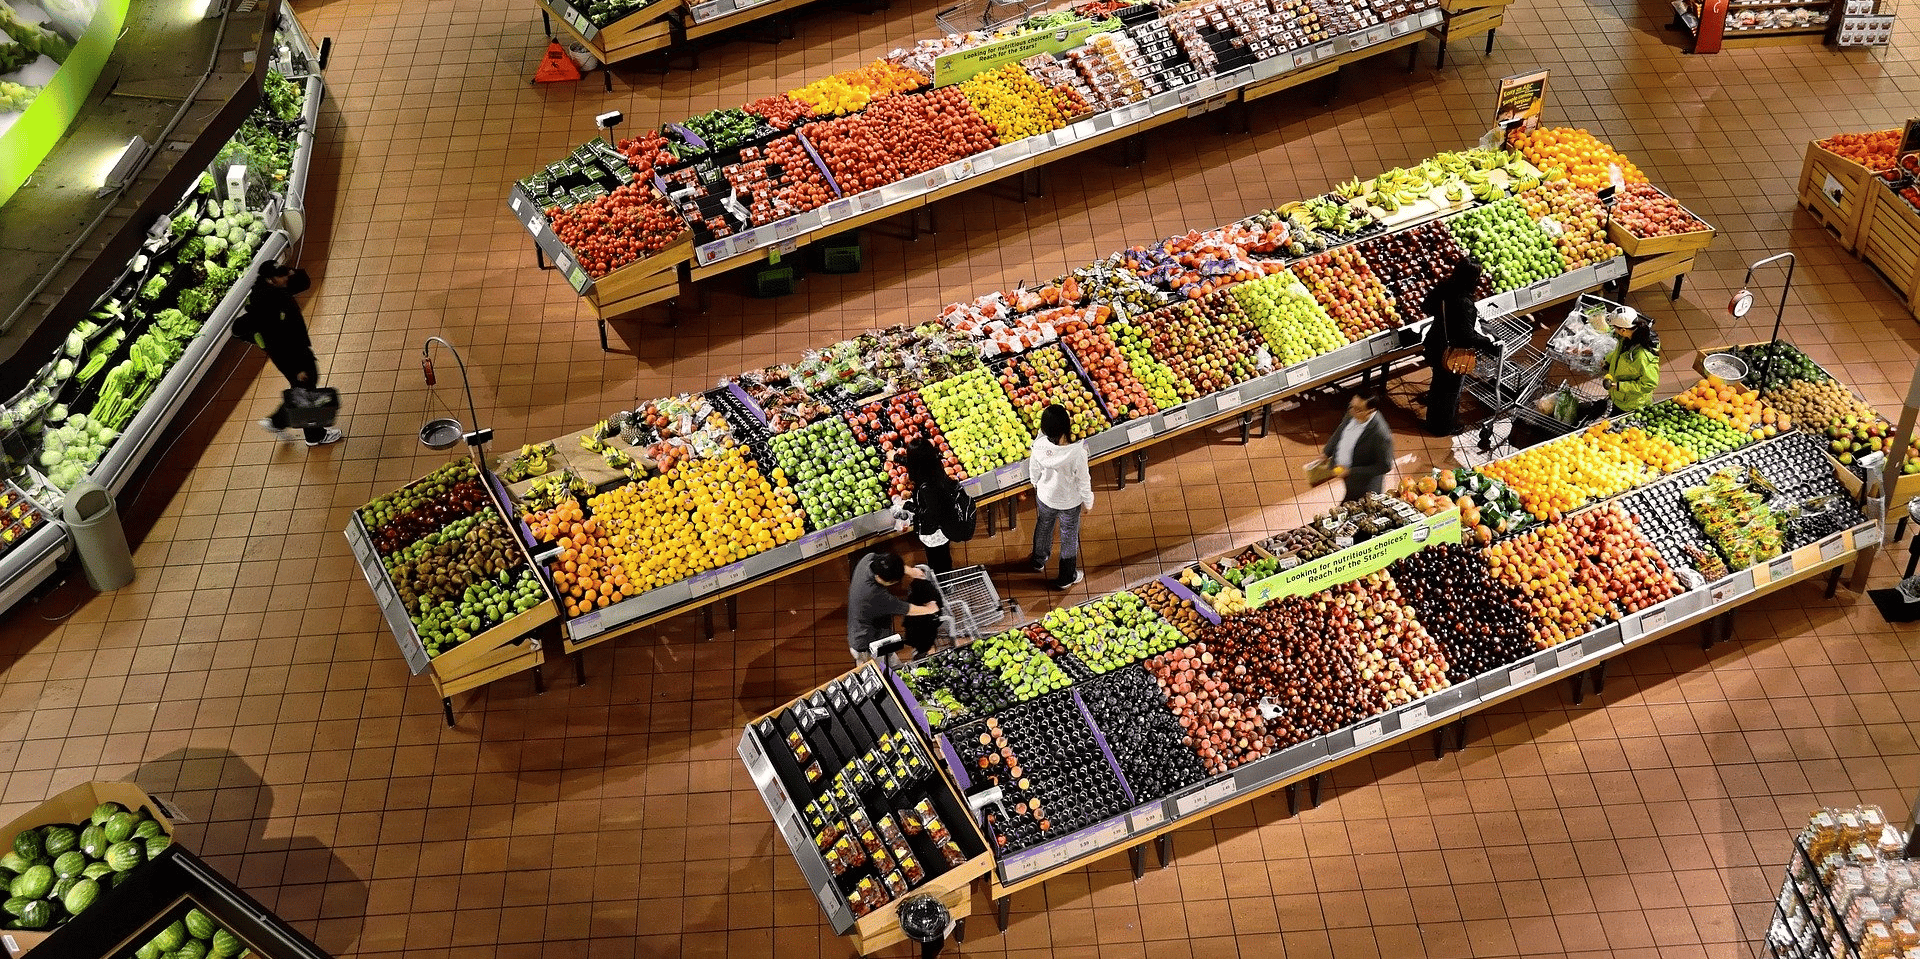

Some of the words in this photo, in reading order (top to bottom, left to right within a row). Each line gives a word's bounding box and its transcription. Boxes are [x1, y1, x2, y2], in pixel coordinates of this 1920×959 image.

[963, 49, 987, 60] Looking
[987, 46, 996, 54] for
[997, 39, 1027, 52] nutritious
[1028, 32, 1053, 44] choices?
[978, 52, 997, 62] Reach
[1008, 48, 1018, 56] the
[1019, 43, 1038, 54] Stars!
[1285, 566, 1318, 584] Looking
[1318, 560, 1331, 572] for
[1332, 547, 1373, 568] nutritious
[1373, 532, 1408, 550] choices?
[1307, 569, 1334, 584] Reach
[1334, 563, 1347, 574] for
[1348, 558, 1362, 570] the
[1362, 548, 1388, 564] Stars!
